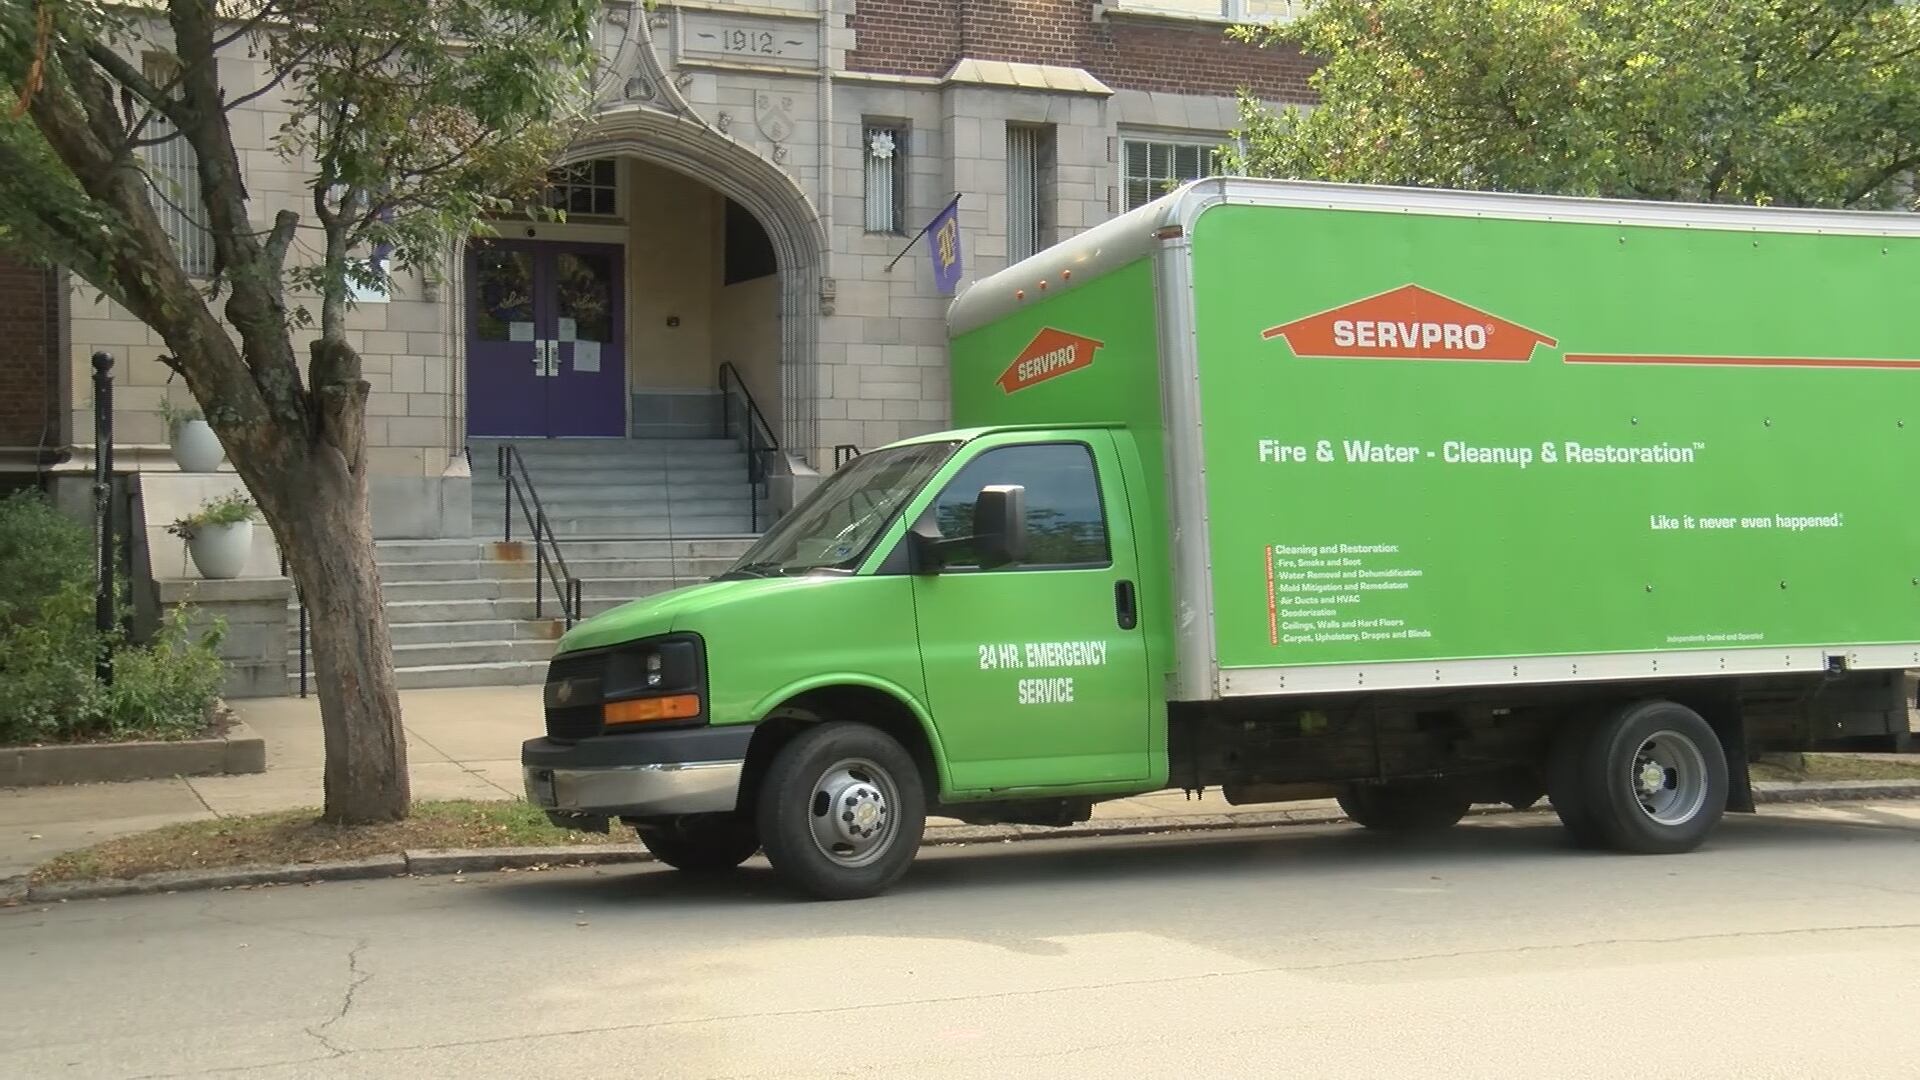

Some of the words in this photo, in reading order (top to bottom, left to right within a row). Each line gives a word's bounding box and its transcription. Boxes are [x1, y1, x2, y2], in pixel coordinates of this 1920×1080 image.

[1258, 439, 1306, 462] Fire
[1315, 440, 1334, 462] &
[1343, 440, 1420, 462] Water
[1443, 441, 1532, 468] Cleanup
[1540, 442, 1558, 462] &
[1650, 514, 1678, 530] Like
[1684, 514, 1694, 530] it
[1700, 517, 1736, 529] never
[1740, 516, 1772, 528] even
[1276, 544, 1318, 556] Cleaning
[1320, 544, 1338, 554] and
[1298, 558, 1324, 566] Smoke
[1326, 558, 1342, 566] and
[1342, 558, 1362, 566] Soot
[1342, 570, 1358, 578] and
[1358, 568, 1423, 578] Dehumidification
[1302, 584, 1342, 593] Mitigation
[1344, 582, 1359, 590] and
[1360, 582, 1408, 590] Remediation
[1294, 596, 1319, 604] Ducts
[1320, 596, 1335, 604] and
[1336, 594, 1360, 603] HVAC
[1317, 620, 1340, 628] Walls
[1341, 620, 1356, 628] and
[1357, 618, 1378, 627] Hard
[1380, 618, 1404, 626] Floors
[1362, 632, 1390, 640] Drapes
[1392, 630, 1406, 638] and
[1408, 629, 1432, 638] Blinds
[978, 644, 997, 670] 24
[998, 644, 1024, 668] HR.
[1024, 640, 1106, 668] EMERGENCY
[1018, 677, 1074, 704] SERVICE
